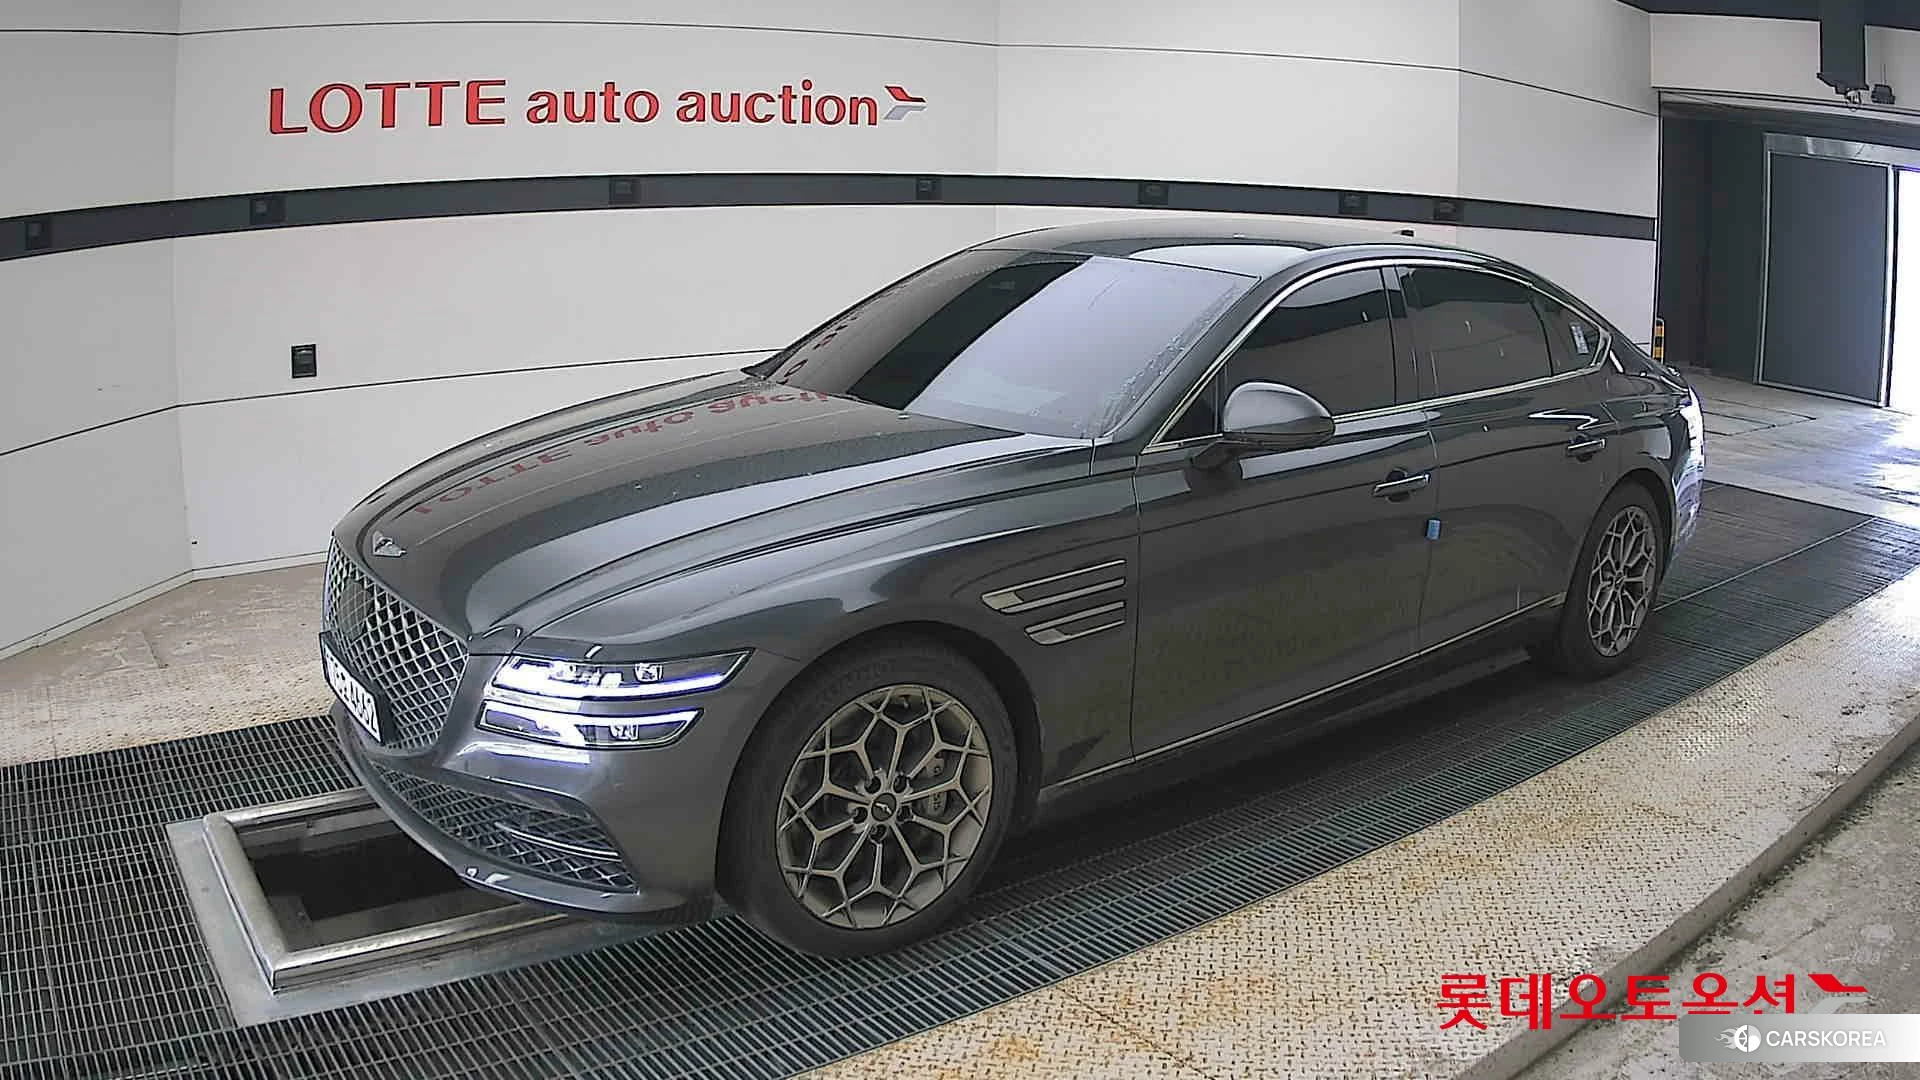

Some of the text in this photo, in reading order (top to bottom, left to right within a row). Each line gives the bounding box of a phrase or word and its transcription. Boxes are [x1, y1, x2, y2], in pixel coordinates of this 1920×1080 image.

[269, 79, 878, 135] LOTTE auto auction
